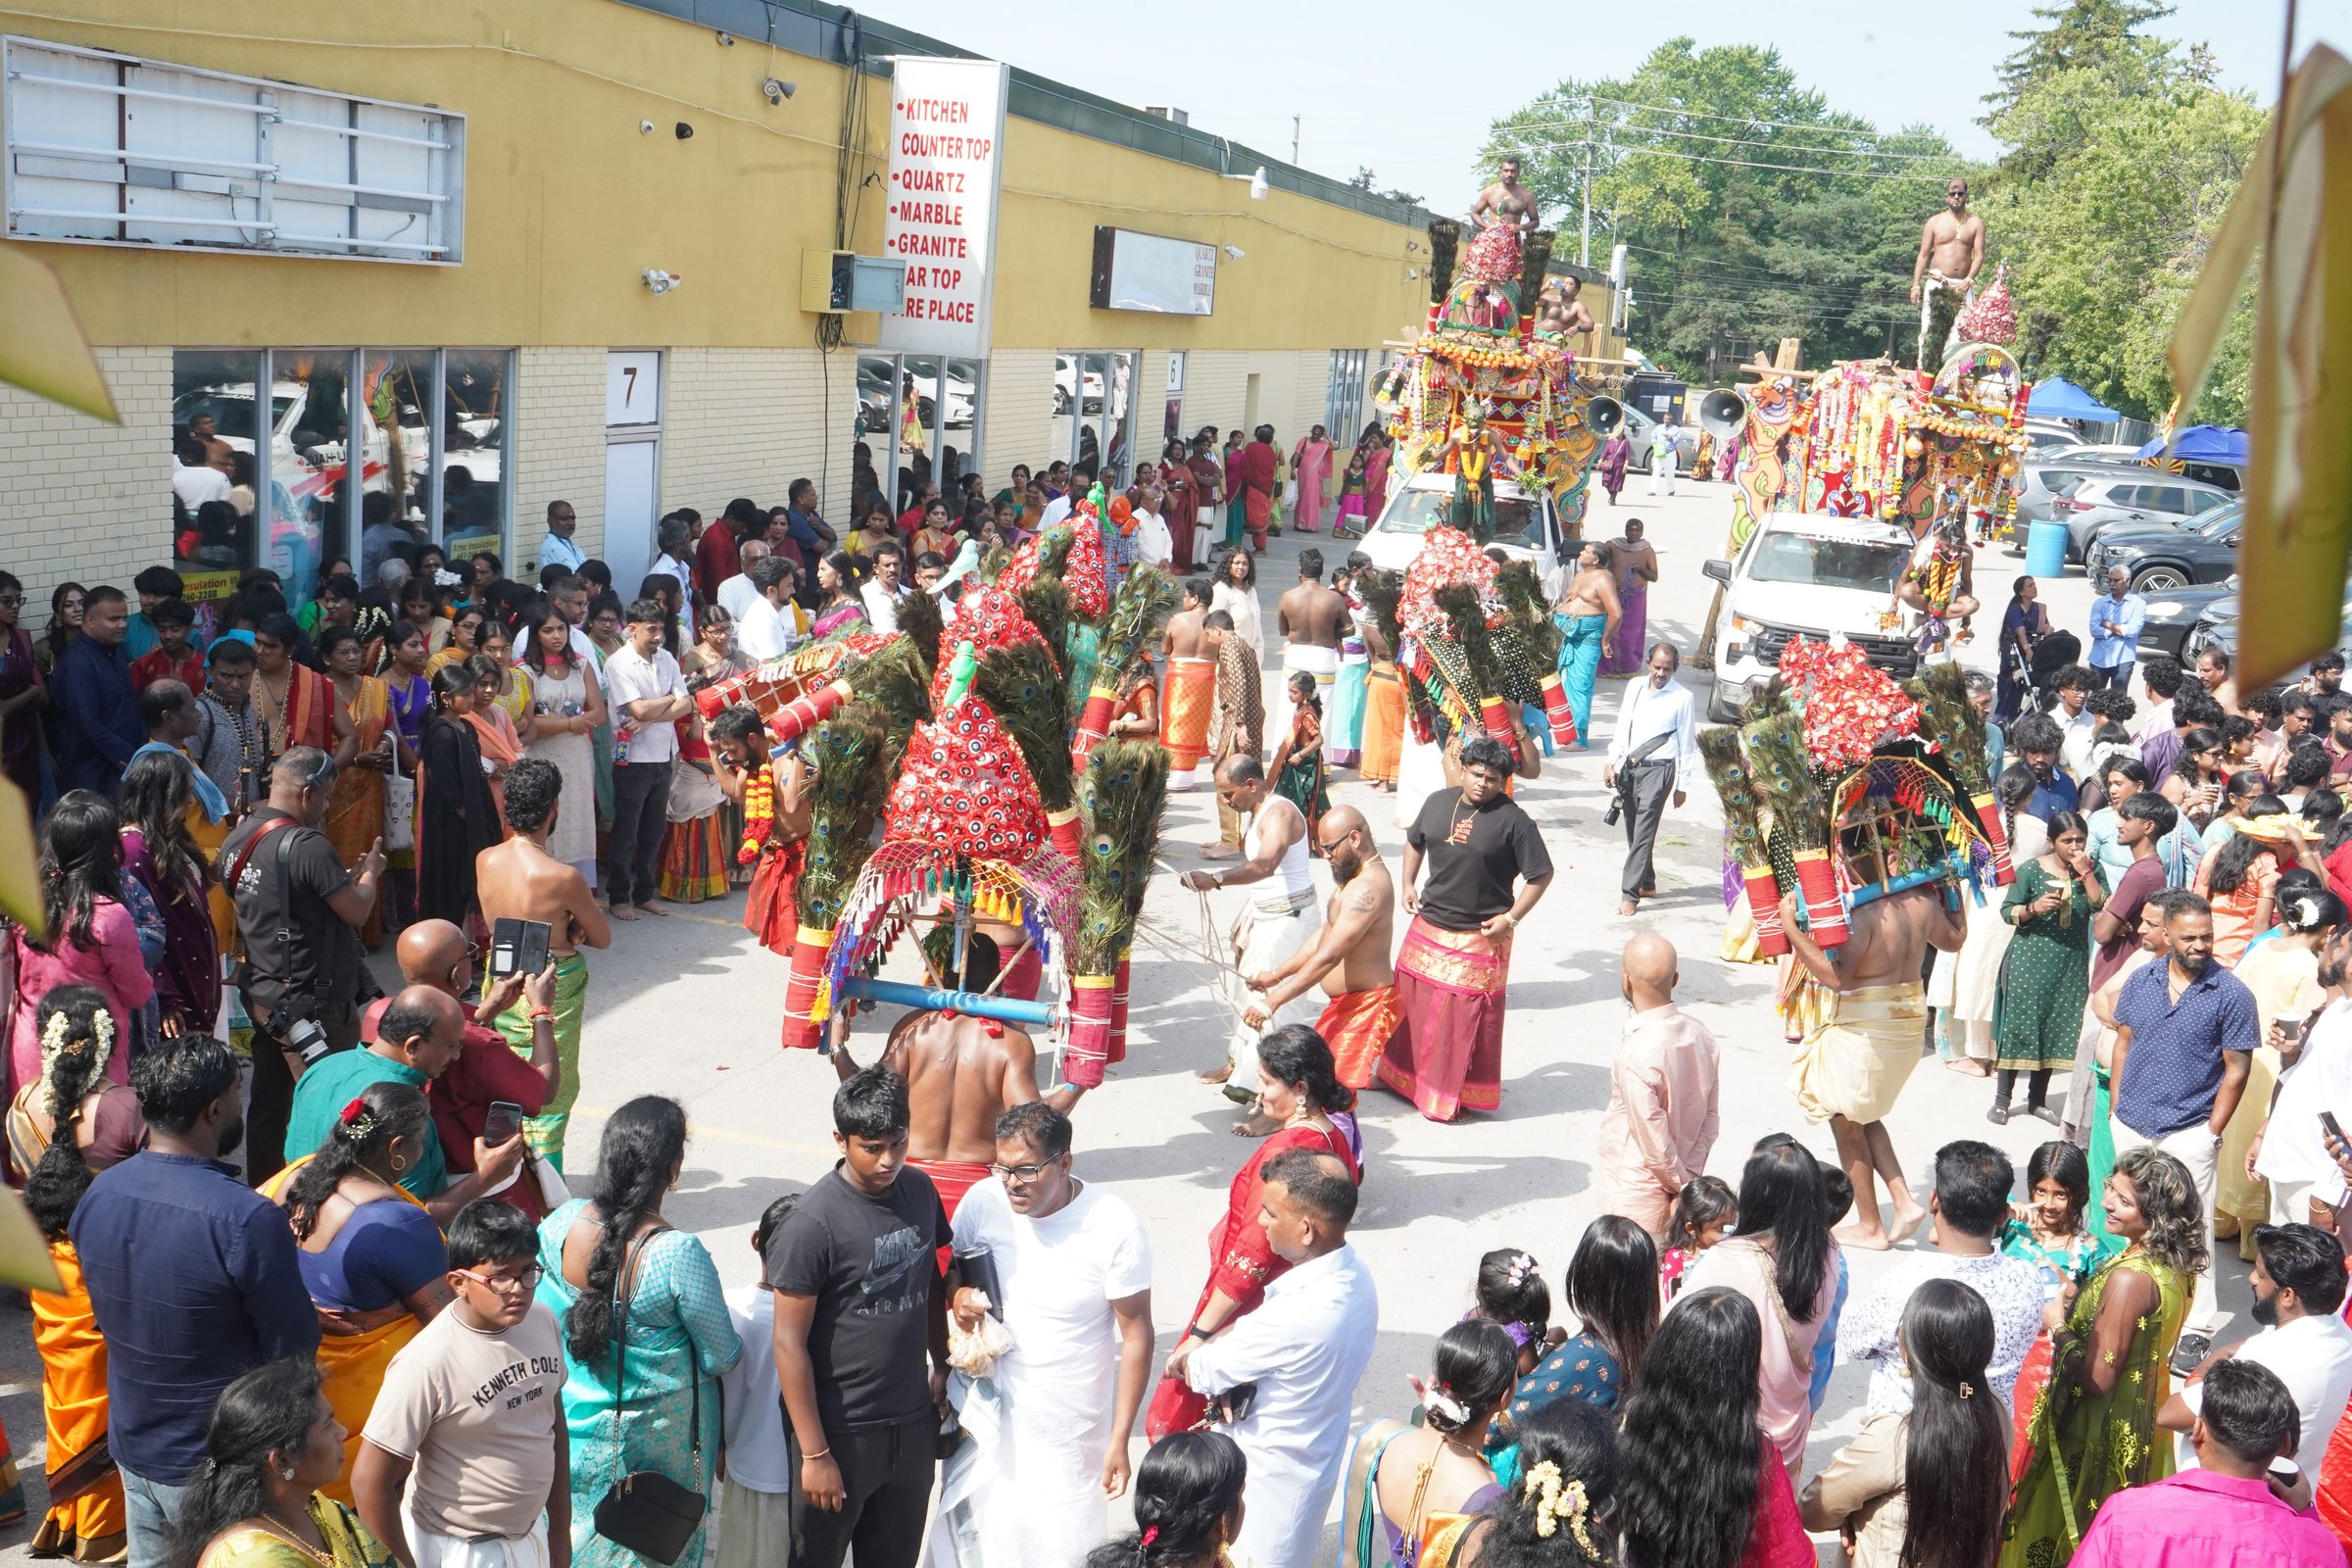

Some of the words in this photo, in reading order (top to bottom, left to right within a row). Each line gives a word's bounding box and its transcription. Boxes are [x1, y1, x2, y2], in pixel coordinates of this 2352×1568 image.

[906, 98, 968, 123] KITCHEN
[902, 133, 962, 159] COUNTER
[966, 138, 991, 161] TOP
[903, 169, 965, 193] QUARTZ
[900, 201, 963, 225] MARBLE
[898, 232, 967, 259] GRANITE
[906, 266, 927, 287] AR
[931, 268, 961, 290] TOP
[892, 297, 925, 318] RE
[928, 300, 974, 323] PLACE
[1171, 359, 1176, 383] 6
[623, 368, 637, 409] 7
[857, 1299, 892, 1314] AIR
[471, 1362, 528, 1408] KENNETH
[530, 1356, 559, 1375] COLE
[507, 1395, 522, 1410] NEW
[524, 1386, 543, 1402] YORK
